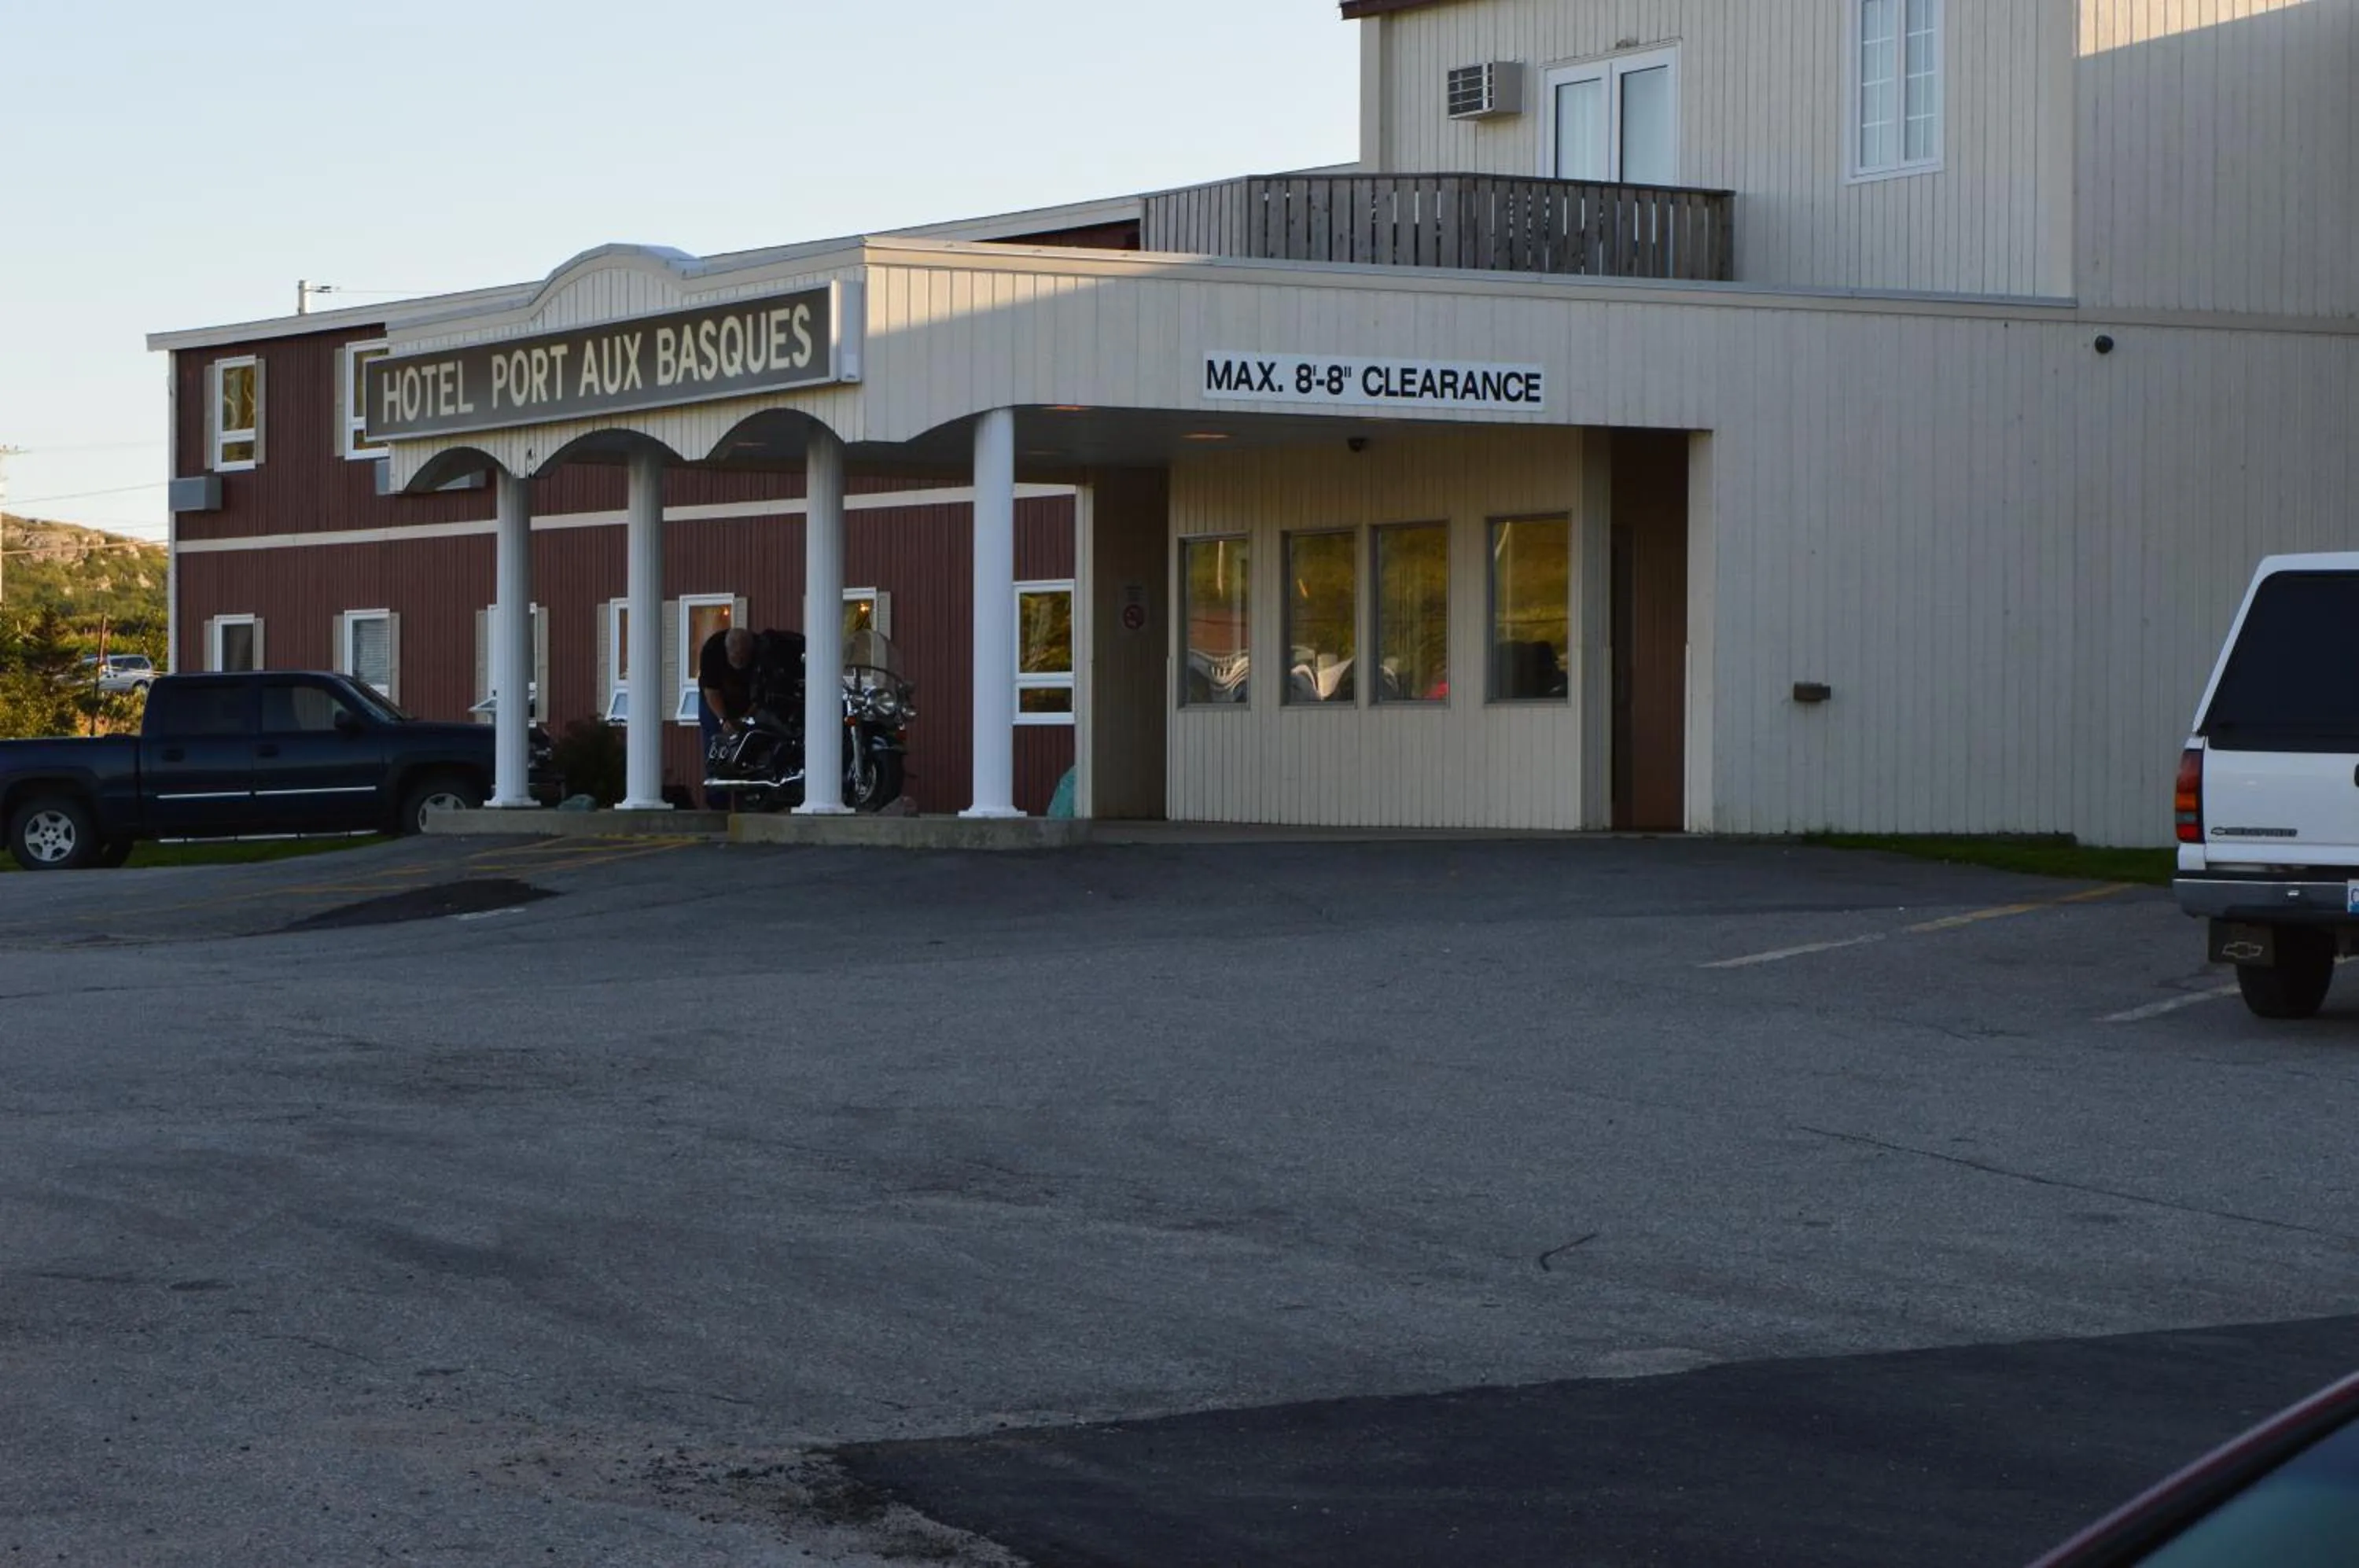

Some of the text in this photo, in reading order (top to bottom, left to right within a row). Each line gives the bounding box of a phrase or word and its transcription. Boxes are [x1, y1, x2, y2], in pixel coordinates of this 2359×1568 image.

[382, 303, 813, 424] HOTEL PORT AUX BASQUES
[1205, 359, 1284, 392] MAX.
[1361, 365, 1542, 403] CLEARANCE
